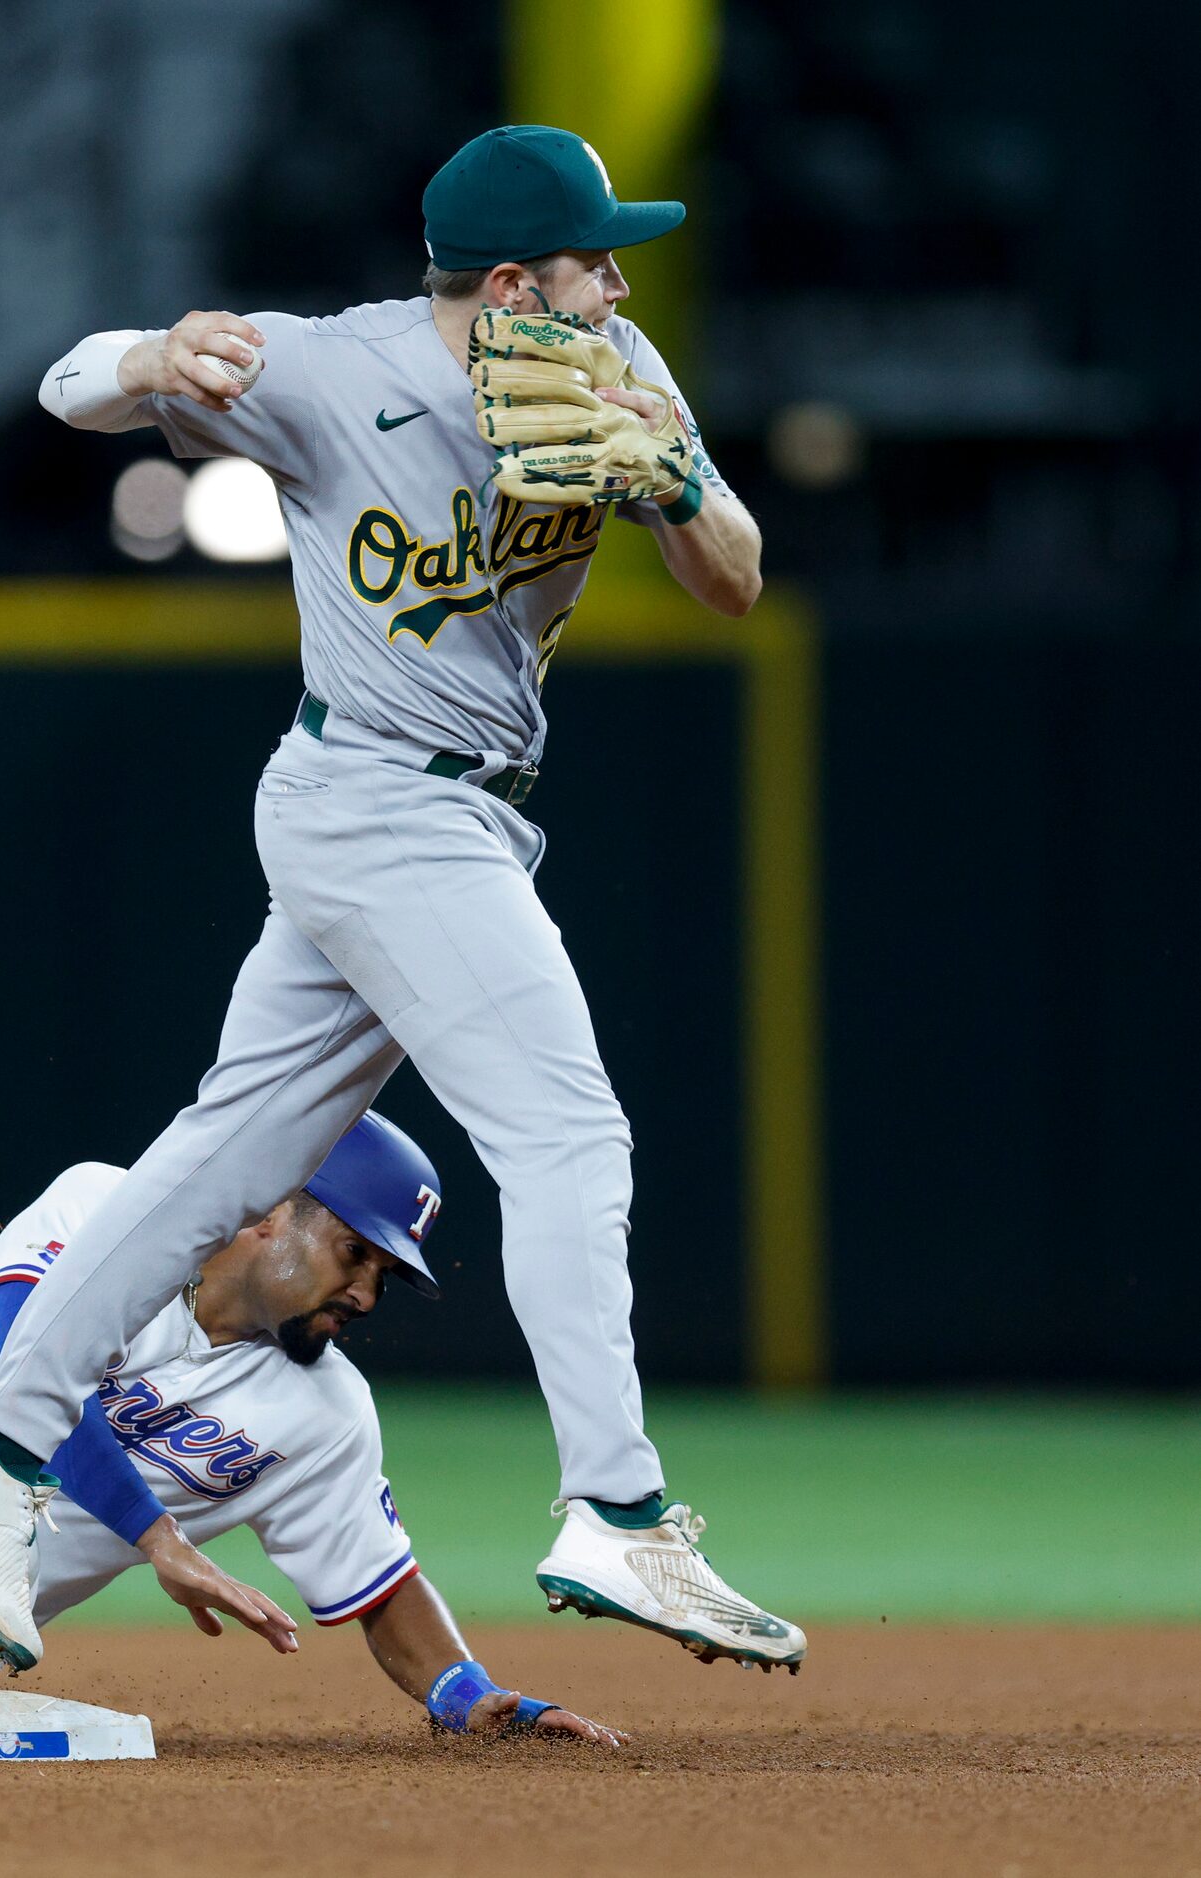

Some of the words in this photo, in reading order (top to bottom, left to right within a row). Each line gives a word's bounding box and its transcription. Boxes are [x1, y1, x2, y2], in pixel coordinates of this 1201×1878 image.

[511, 319, 575, 345] Rawlings
[521, 459, 537, 467] THE
[538, 457, 558, 466] GOLD
[559, 455, 581, 464] GLOVE
[347, 486, 604, 606] Oaklan
[409, 1183, 442, 1241] T
